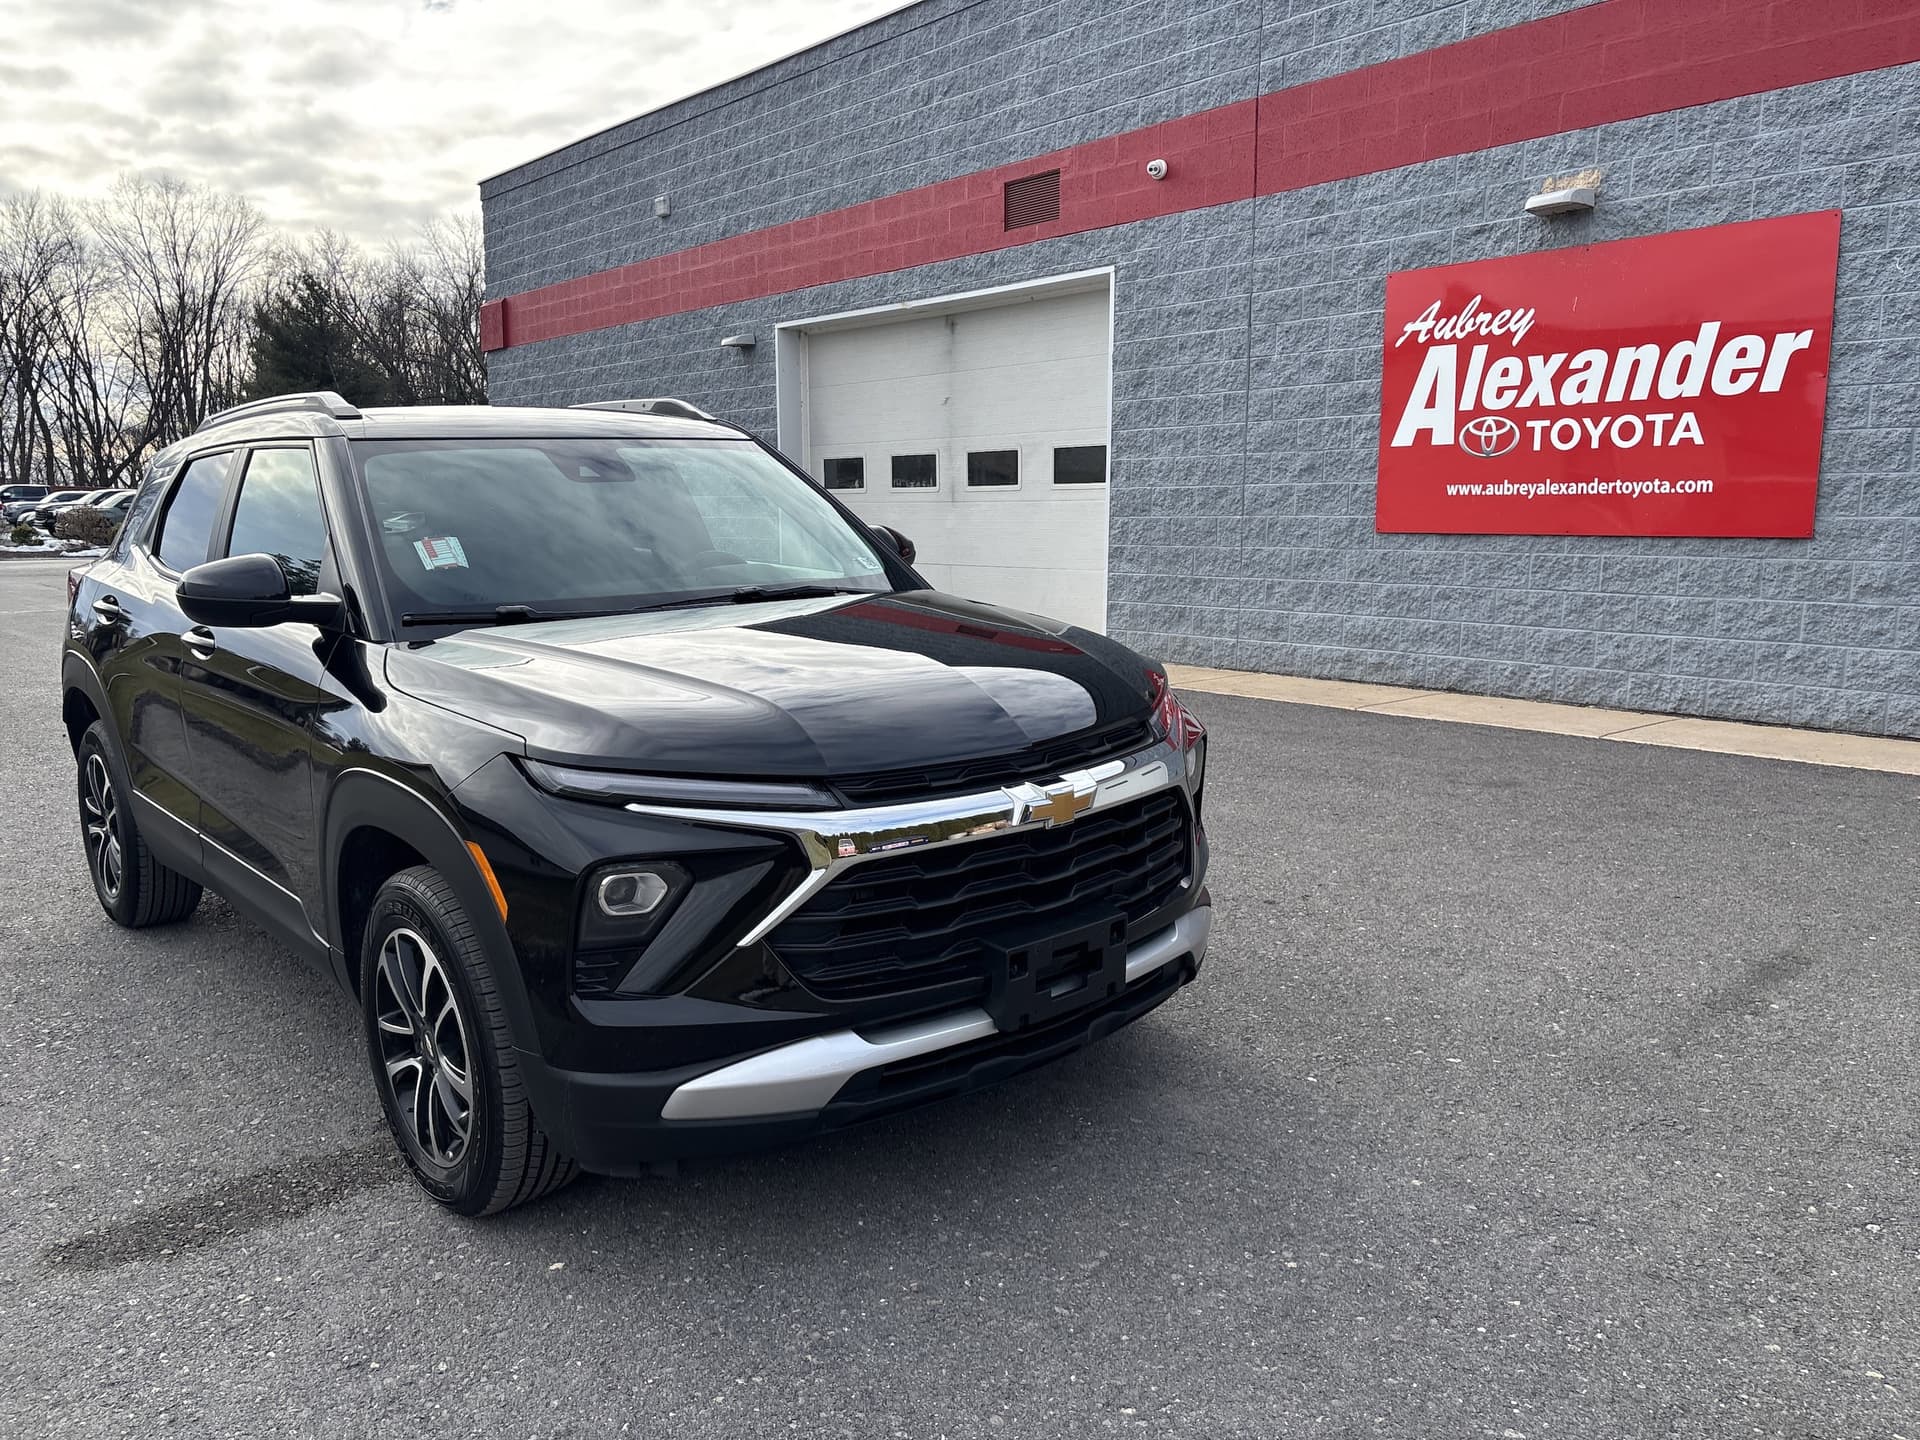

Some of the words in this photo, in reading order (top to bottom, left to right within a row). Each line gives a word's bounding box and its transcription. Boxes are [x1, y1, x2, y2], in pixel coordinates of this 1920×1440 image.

[1395, 294, 1536, 348] Aubrey
[1391, 320, 1814, 448] Alexander
[1526, 411, 1705, 452] TOYOTA
[1446, 476, 1714, 499] www.aubreyalexandertoyota.com
